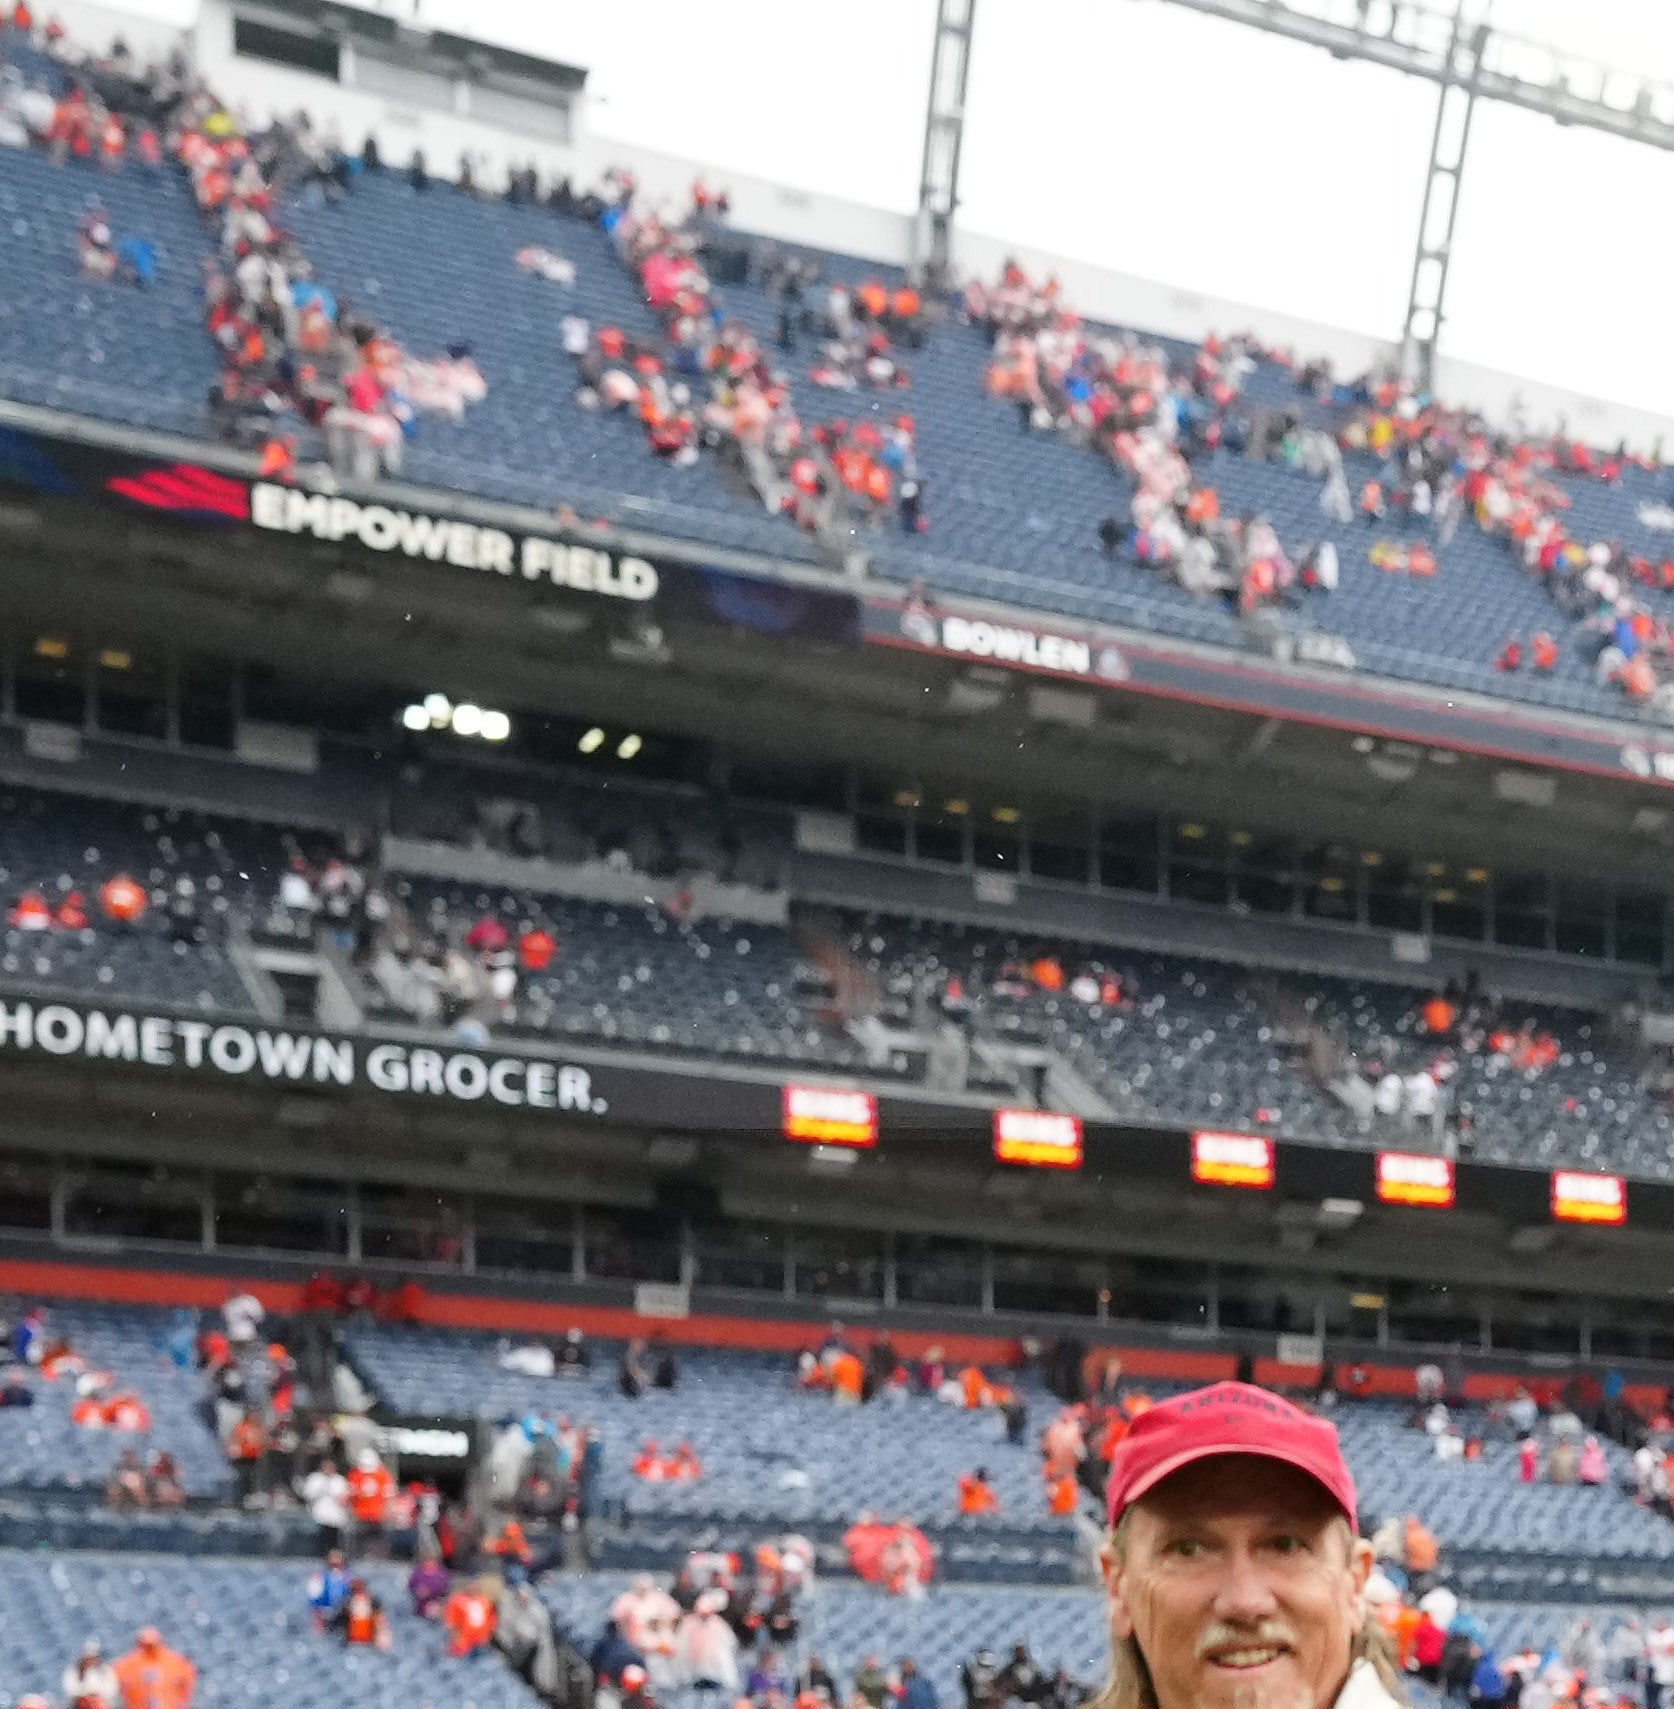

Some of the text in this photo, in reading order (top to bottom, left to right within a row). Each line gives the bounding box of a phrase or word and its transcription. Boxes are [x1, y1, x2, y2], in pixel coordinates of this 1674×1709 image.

[250, 483, 660, 600] EMPOWER FIELD
[942, 616, 1090, 674] BOWLEN
[0, 1004, 608, 1116] HOMETOWN GROCER.
